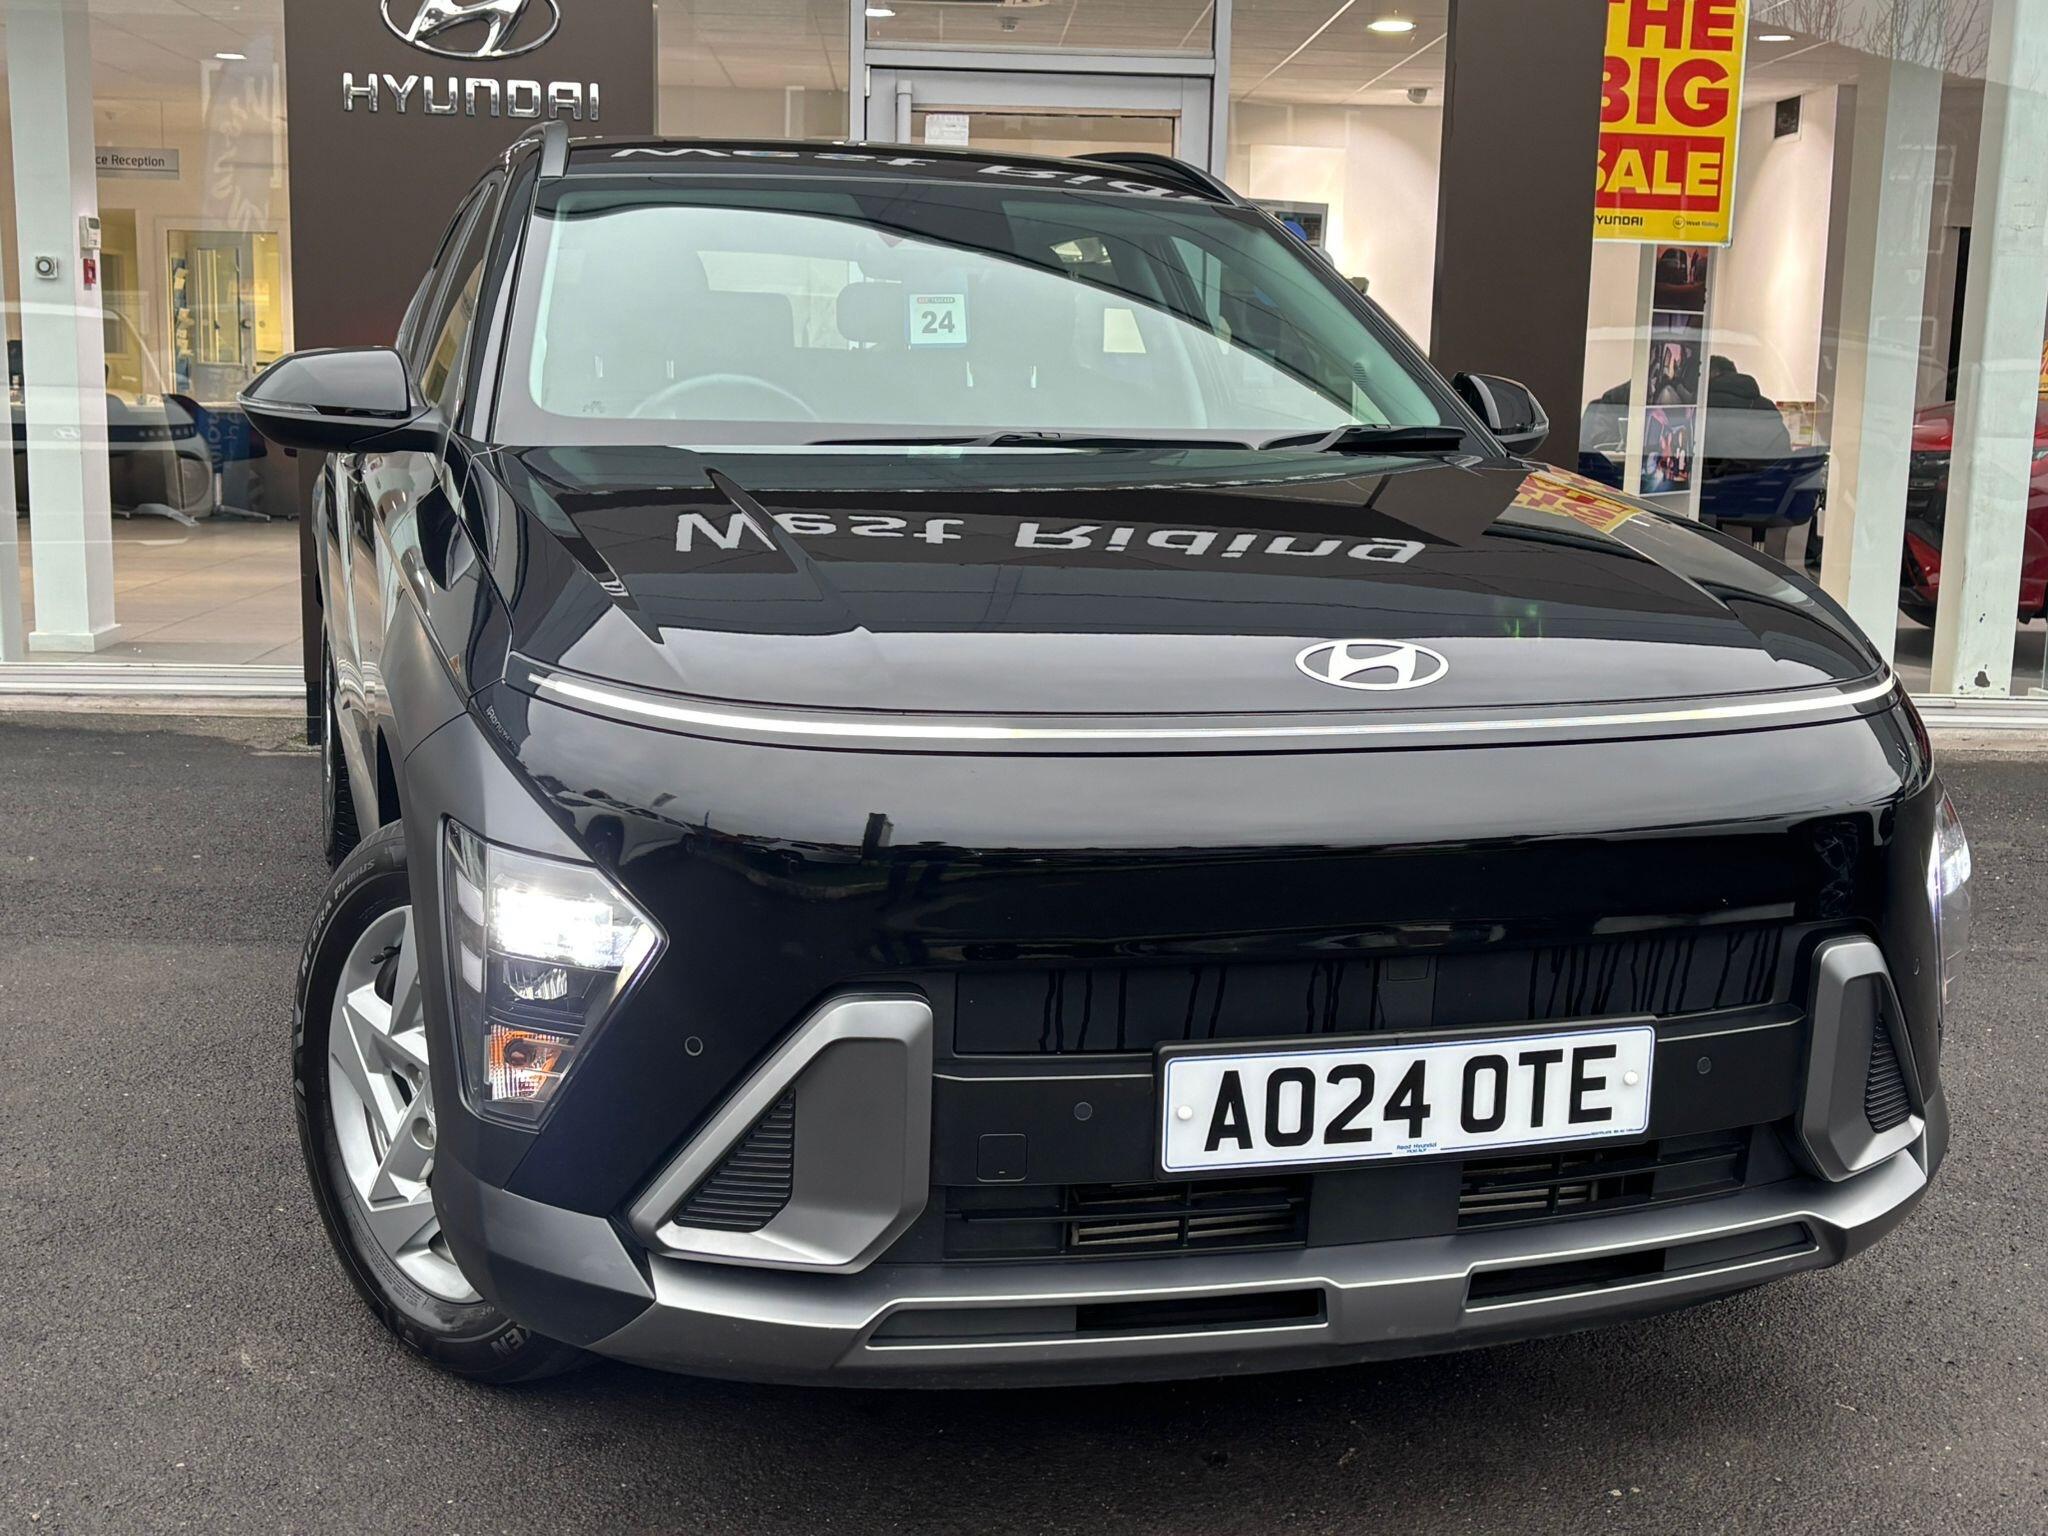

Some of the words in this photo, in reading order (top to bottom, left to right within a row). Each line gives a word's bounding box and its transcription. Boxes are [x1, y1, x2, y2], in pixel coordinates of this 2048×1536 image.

[1609, 0, 1737, 51] HE
[342, 72, 600, 121] HYUNDAI
[111, 154, 166, 168] Reception
[1596, 215, 1644, 227] YUNDAI
[921, 310, 956, 334] 24
[1203, 1059, 1431, 1152] AO24
[1460, 1044, 1617, 1134] OTE
